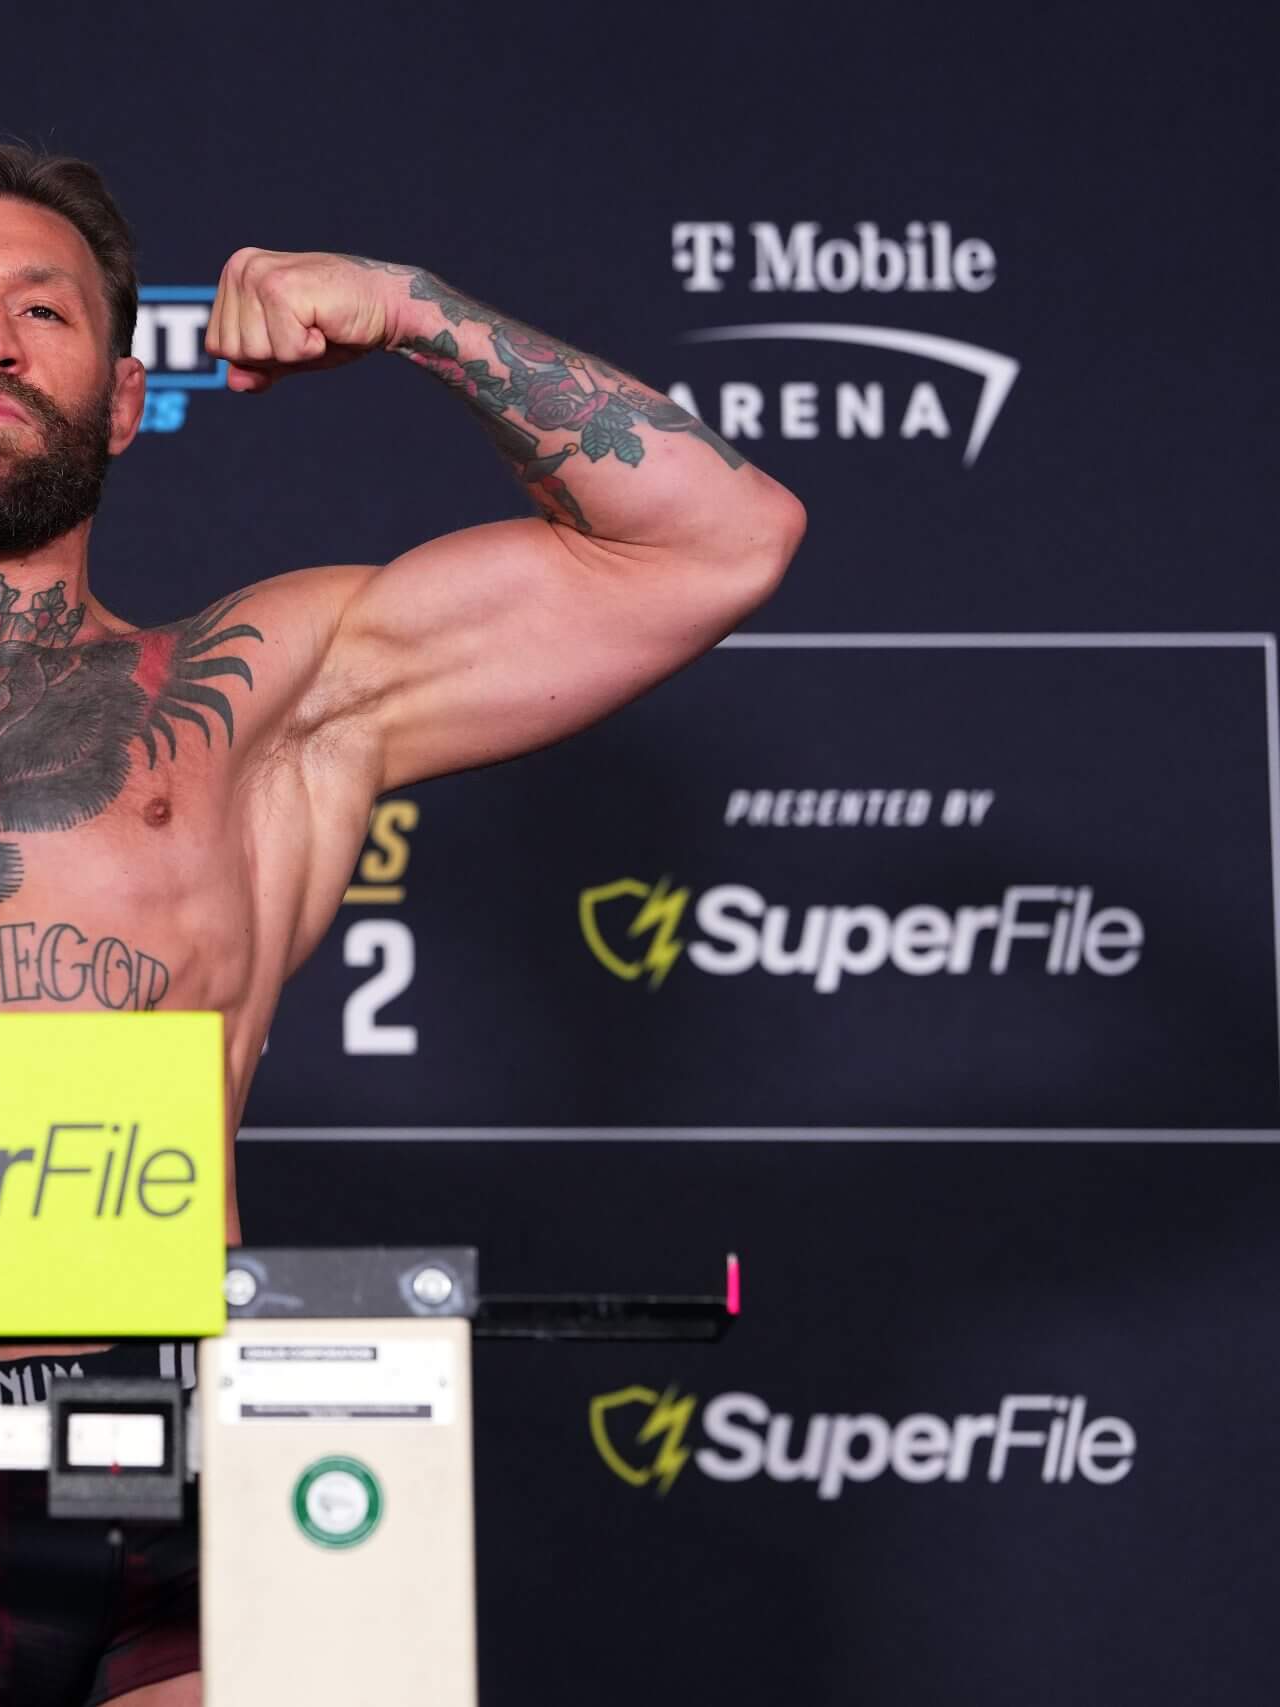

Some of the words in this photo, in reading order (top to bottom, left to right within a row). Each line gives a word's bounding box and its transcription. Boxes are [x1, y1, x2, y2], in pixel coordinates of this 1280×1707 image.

[749, 220, 998, 293] Mobile
[723, 788, 933, 827] PRESENTED
[940, 788, 995, 827] BY
[342, 918, 418, 1056] 2
[687, 885, 1145, 994] SuperFile
[695, 1392, 1136, 1500] SuperFile
